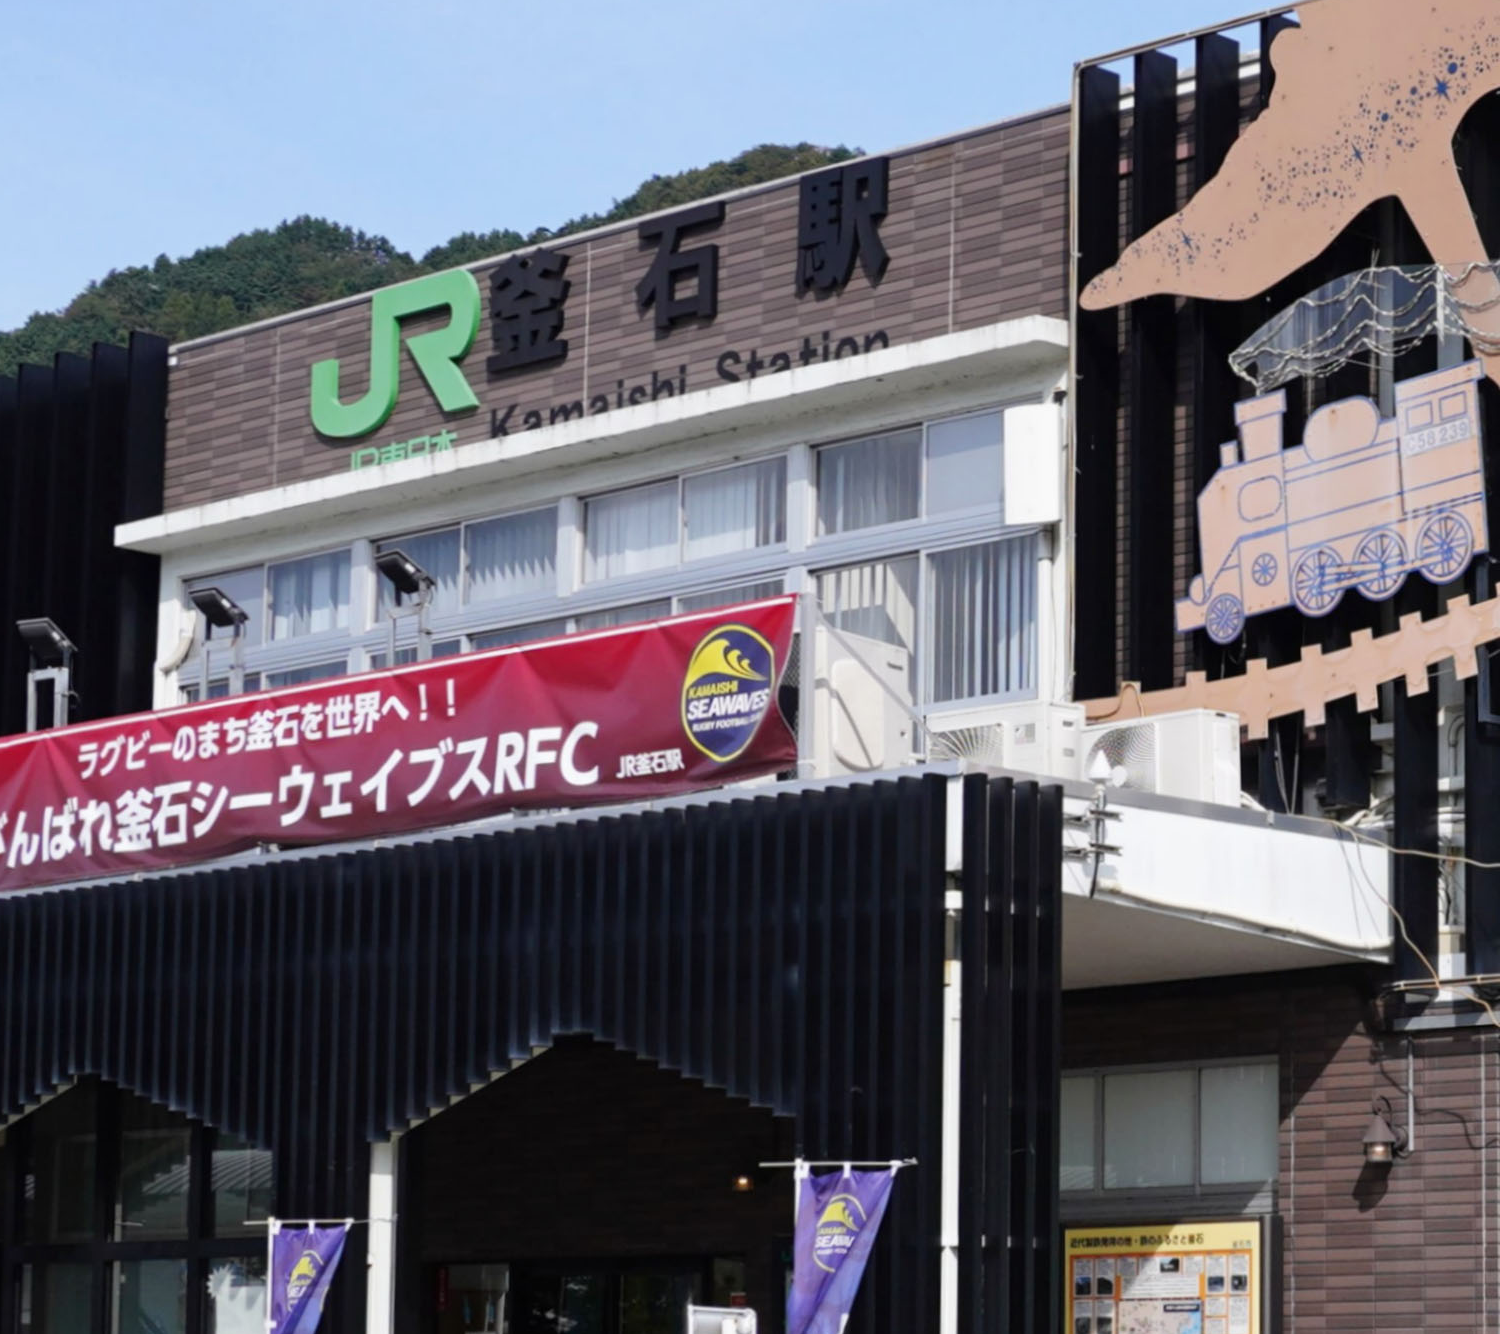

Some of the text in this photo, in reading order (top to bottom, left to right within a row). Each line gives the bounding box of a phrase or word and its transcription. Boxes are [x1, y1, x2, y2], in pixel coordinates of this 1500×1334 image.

[487, 156, 892, 375] 釜石駅
[311, 269, 482, 438] JR
[489, 328, 890, 439] Kamaishi Station
[687, 688, 771, 721] SEAWAVES
[688, 680, 739, 699] KAMAISHI
[616, 747, 685, 780] JR釜石駅
